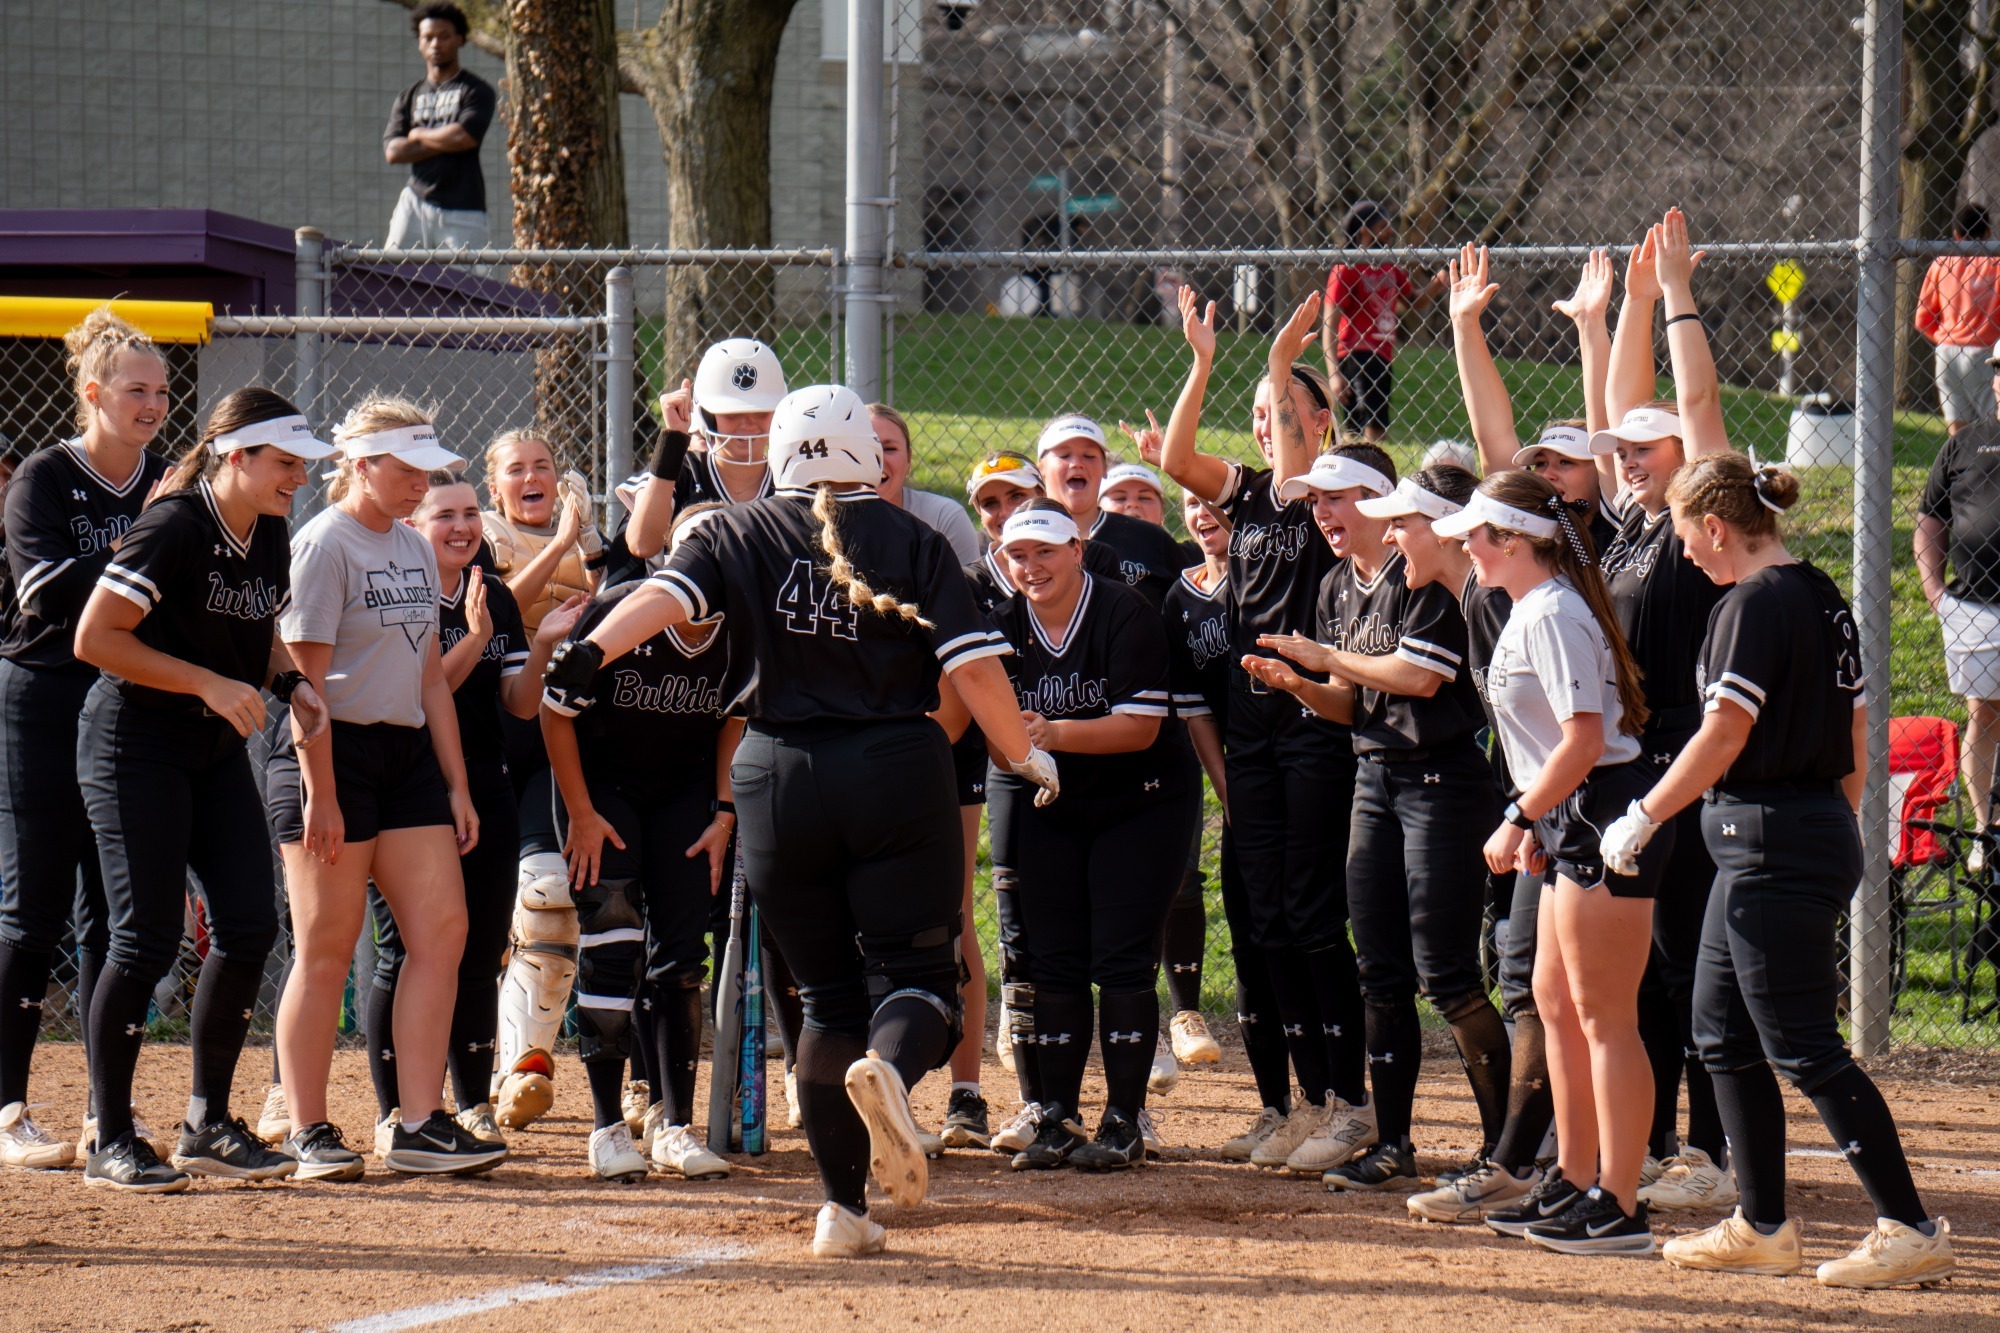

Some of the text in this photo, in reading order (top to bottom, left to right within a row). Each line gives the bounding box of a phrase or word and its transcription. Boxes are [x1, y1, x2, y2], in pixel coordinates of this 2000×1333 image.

[798, 438, 829, 460] 44
[1228, 523, 1309, 562] ulldogs
[776, 558, 859, 641] 44
[612, 669, 726, 720] Bulldo
